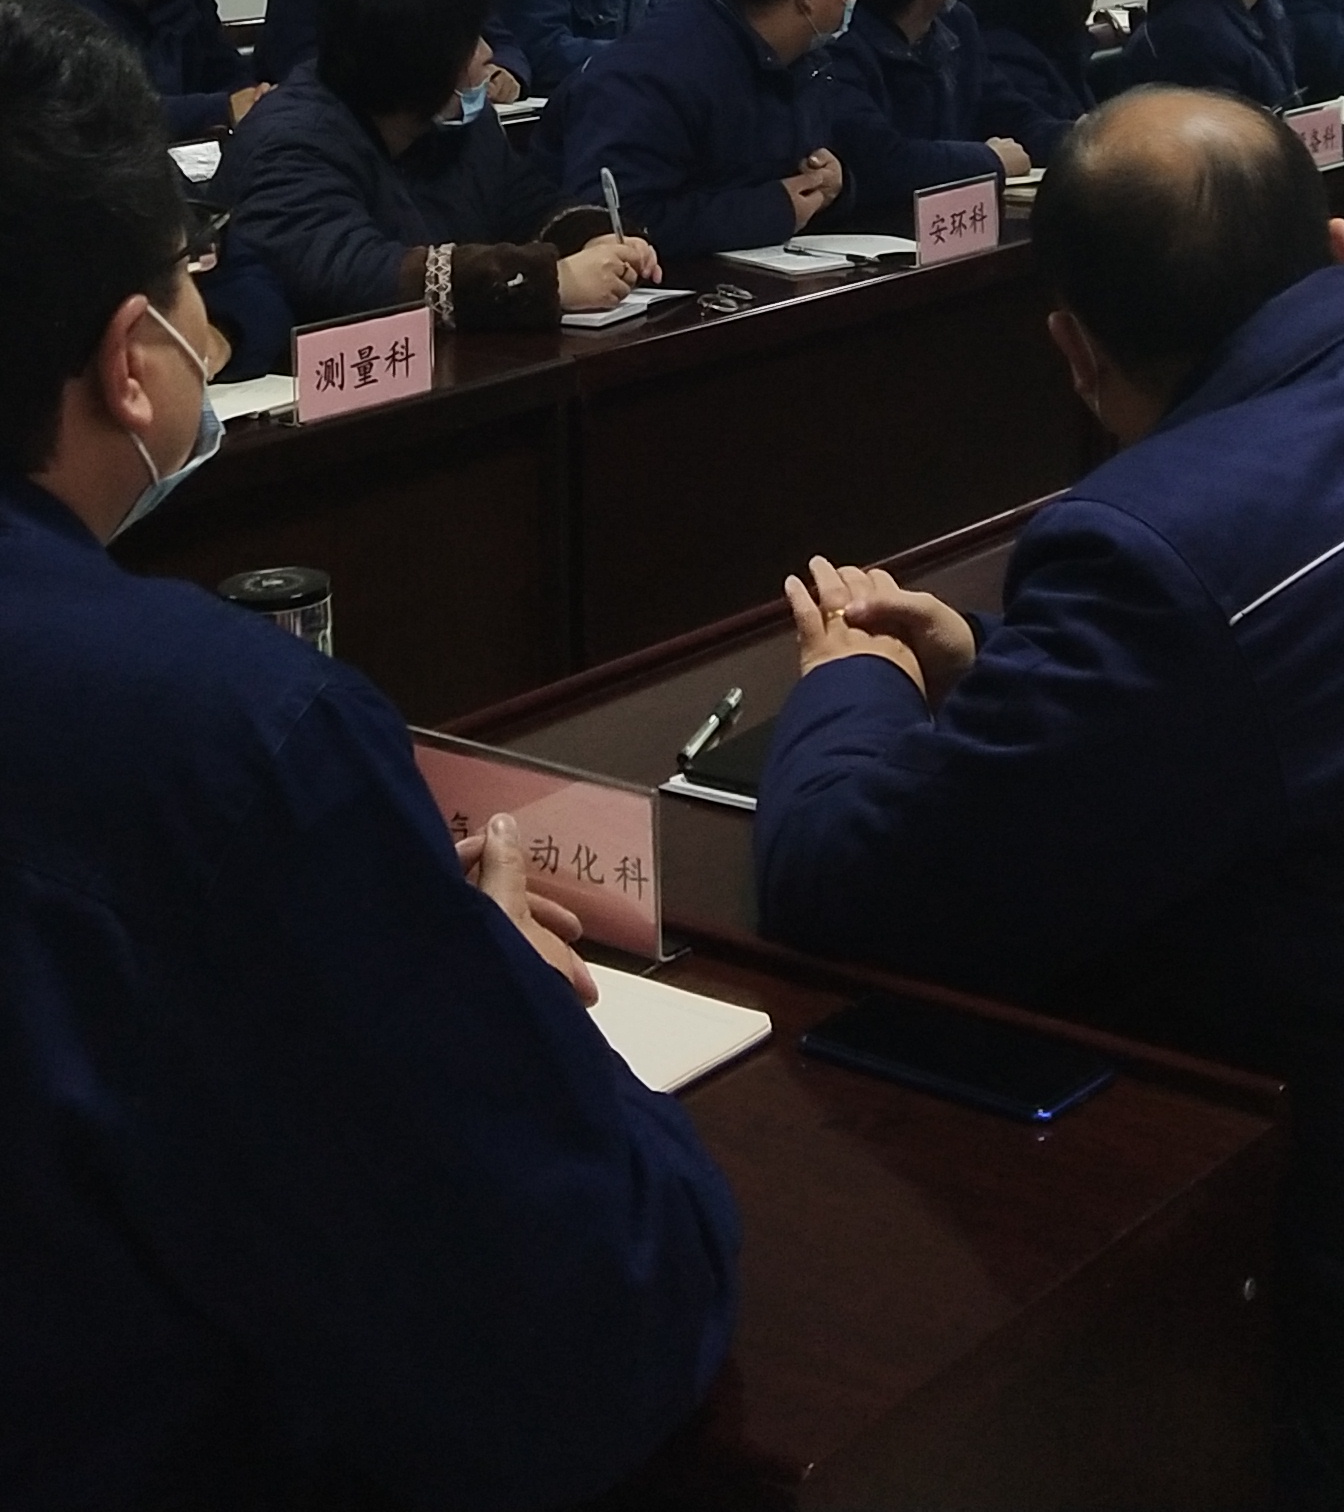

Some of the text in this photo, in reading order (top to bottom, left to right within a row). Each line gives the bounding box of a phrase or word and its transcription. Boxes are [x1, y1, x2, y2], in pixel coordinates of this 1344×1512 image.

[929, 202, 988, 246] 安环科
[316, 336, 416, 393] 测量科
